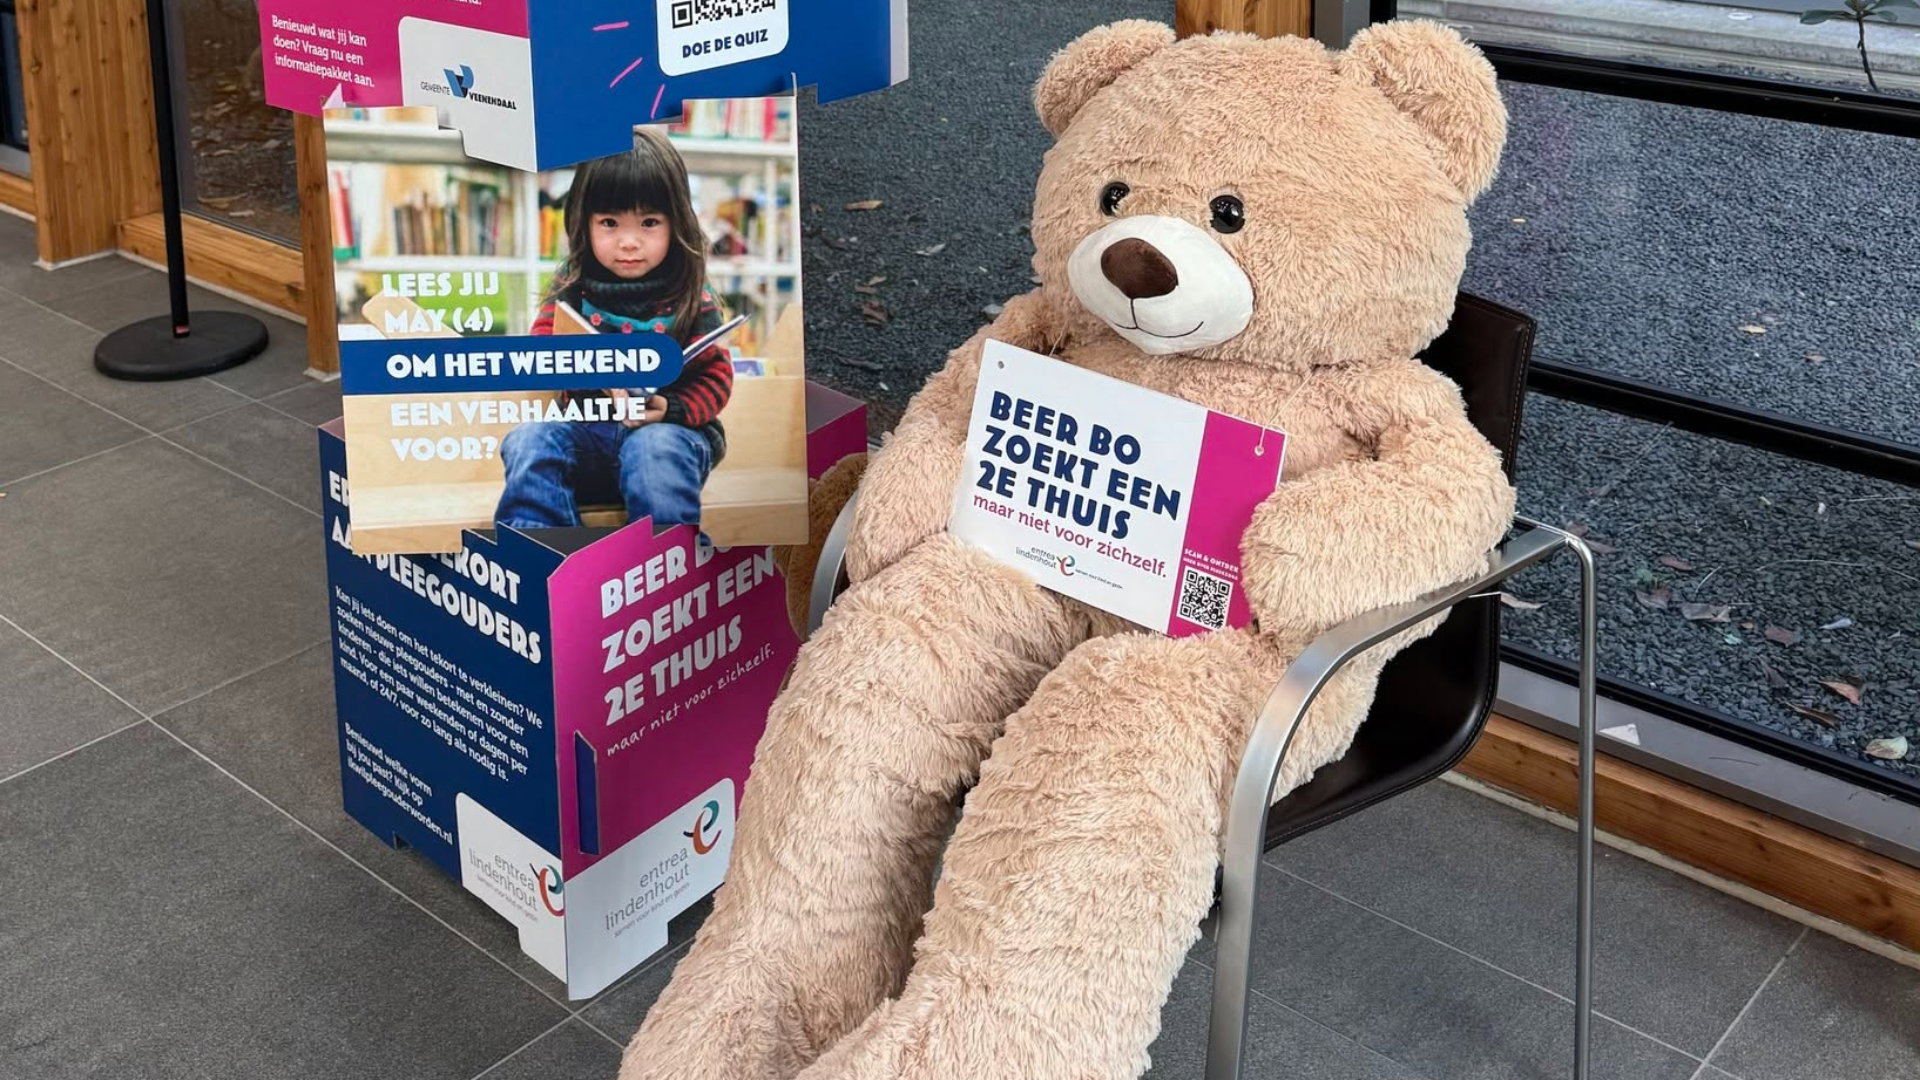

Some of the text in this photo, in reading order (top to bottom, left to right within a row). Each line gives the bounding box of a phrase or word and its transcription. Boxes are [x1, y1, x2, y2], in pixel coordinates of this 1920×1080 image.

[272, 15, 367, 47] Benieuwd wat jij kan
[273, 34, 364, 65] doen? Vraag nu een
[682, 28, 769, 59] DOE DE QUIZ
[274, 53, 375, 87] informatiepakket aan.
[420, 81, 517, 110] GEMEENTE VEENENDAAL
[382, 272, 499, 298] LEES JIJ
[384, 306, 494, 333] MAY (4)
[386, 348, 661, 378] OM HET WEEKEND
[390, 397, 646, 427] EEN VERHAALTJE
[990, 390, 1141, 465] BEER BO
[390, 436, 499, 461] VOOR?
[982, 425, 1181, 521] ZOEKT EEN
[976, 460, 1131, 540] 2E THUIS
[973, 495, 1167, 578] maar niet voor zichzelf.
[1016, 547, 1057, 569] lindenhout
[1031, 546, 1055, 561] entrea
[1210, 555, 1239, 573] ONTDEK
[430, 546, 520, 605] KORT
[600, 534, 732, 619] BEER B
[602, 546, 774, 674] ZOEKT EEN
[336, 585, 351, 605] Kan
[376, 614, 397, 637] doen
[398, 631, 413, 647] om
[414, 638, 429, 657] het
[430, 650, 457, 676] tekort
[458, 668, 468, 683] te
[469, 676, 524, 717] verkleinen?
[526, 708, 543, 729] We
[337, 606, 364, 632] zoeken
[365, 625, 395, 652] nieuwe
[396, 646, 448, 688] pleegouders
[456, 686, 475, 705] met
[476, 700, 489, 714] en
[490, 708, 525, 736] zonder
[604, 614, 742, 726] 2E THUIS
[338, 620, 372, 654] kinderen
[379, 650, 392, 668] die
[392, 659, 408, 678] iets
[409, 671, 435, 698] willen
[437, 687, 484, 730] betekenen
[486, 723, 508, 744] voor
[509, 738, 529, 758] een
[359, 651, 378, 674] Voor
[379, 669, 395, 686] een
[395, 680, 414, 700] paar
[415, 693, 466, 736] weekenden
[468, 729, 477, 742] of
[479, 736, 509, 764] dagen
[511, 757, 528, 776] per
[607, 643, 775, 756] maar niet voor zichzelf.
[345, 722, 433, 797] Benieuwd welke vorm
[370, 679, 379, 692] of
[400, 701, 420, 720] voor
[420, 714, 431, 728] zo
[433, 720, 453, 746] lang
[454, 737, 467, 753] als
[468, 747, 496, 776] nodig
[498, 764, 509, 781] is.
[411, 792, 423, 807] op
[469, 848, 537, 911] lindenhout
[495, 855, 535, 892] entrea
[605, 862, 689, 930] lindenhout
[640, 847, 688, 888] entrea
